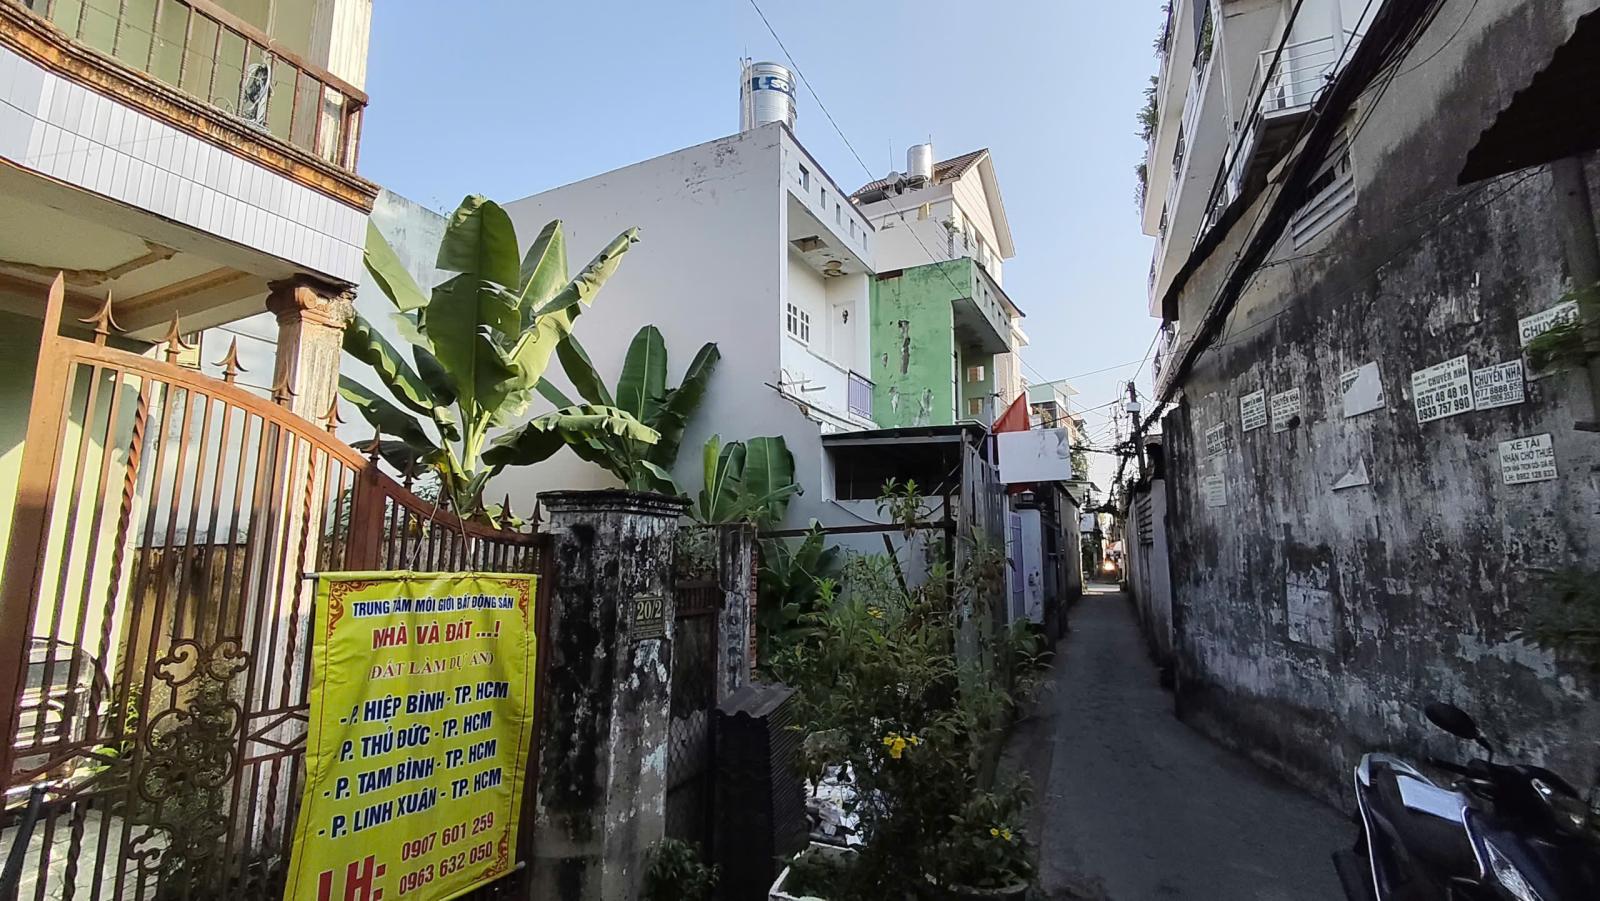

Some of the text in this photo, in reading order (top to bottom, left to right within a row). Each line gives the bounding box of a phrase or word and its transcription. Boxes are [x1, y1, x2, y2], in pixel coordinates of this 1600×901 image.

[1474, 365, 1503, 387] CHUYỂN
[1416, 394, 1434, 408] 0931
[1435, 391, 1445, 402] 48
[1447, 387, 1458, 399] 48
[1459, 384, 1468, 396] 18
[1418, 405, 1437, 421] 0933
[1438, 401, 1452, 415] 757
[1453, 396, 1470, 411] 990
[1510, 441, 1522, 451] XE
[353, 601, 390, 616] TRUNG
[393, 597, 411, 613] TÂM
[415, 597, 436, 612] MÔI
[472, 593, 497, 611] ĐỘNG
[498, 593, 514, 609] SẢN
[636, 600, 662, 620] 20/2
[372, 622, 407, 649] NHÀ
[416, 621, 439, 644] VÀ
[445, 616, 473, 641] ĐẤT
[409, 657, 446, 675] LÀM
[363, 694, 401, 724] HIỆP
[406, 690, 445, 715] BÌNH
[455, 685, 472, 705] TP.
[476, 681, 509, 701] HCM
[361, 725, 393, 758] THỦ
[397, 723, 431, 749] ĐỨC
[442, 718, 458, 739] TP.
[463, 710, 493, 734] HCM
[335, 777, 350, 800] P.
[358, 766, 393, 795] TAM
[396, 757, 435, 784] BÌNH
[445, 749, 464, 770] TP.
[468, 739, 497, 764] HCM
[331, 815, 347, 839] P.
[353, 800, 393, 832] LINH
[396, 786, 438, 818] XUÂN
[451, 778, 470, 800] TP.
[474, 767, 502, 793] HCM
[401, 811, 494, 862] 0907 601 259
[399, 840, 493, 896] 0963 632 050
